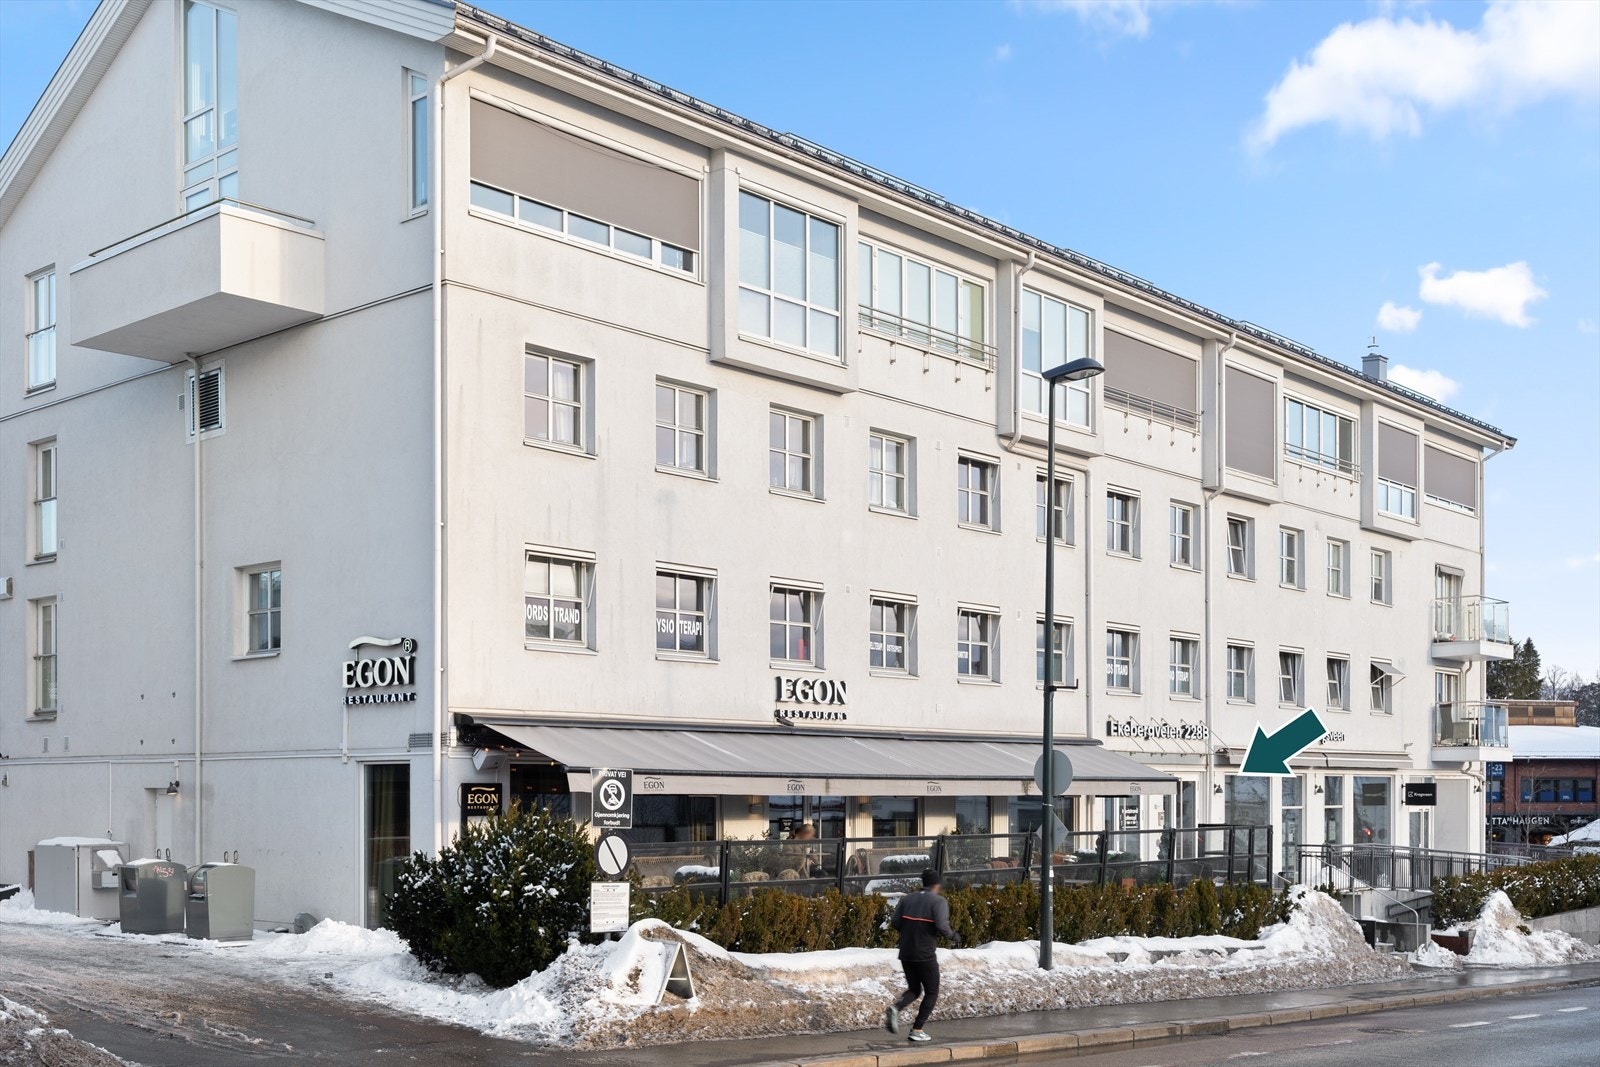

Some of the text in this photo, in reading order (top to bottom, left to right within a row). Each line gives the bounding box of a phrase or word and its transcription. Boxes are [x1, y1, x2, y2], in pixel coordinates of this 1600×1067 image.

[342, 655, 411, 688] EGON
[779, 676, 848, 705] EGON
[341, 692, 412, 705] RESTAURANT
[779, 709, 848, 720] RESTAURANT
[1109, 720, 1210, 740] Ekebergveien 228B
[599, 770, 617, 778] PRIVAT
[643, 781, 665, 789] EGON
[786, 783, 806, 791] EGON
[467, 793, 499, 804] EGON
